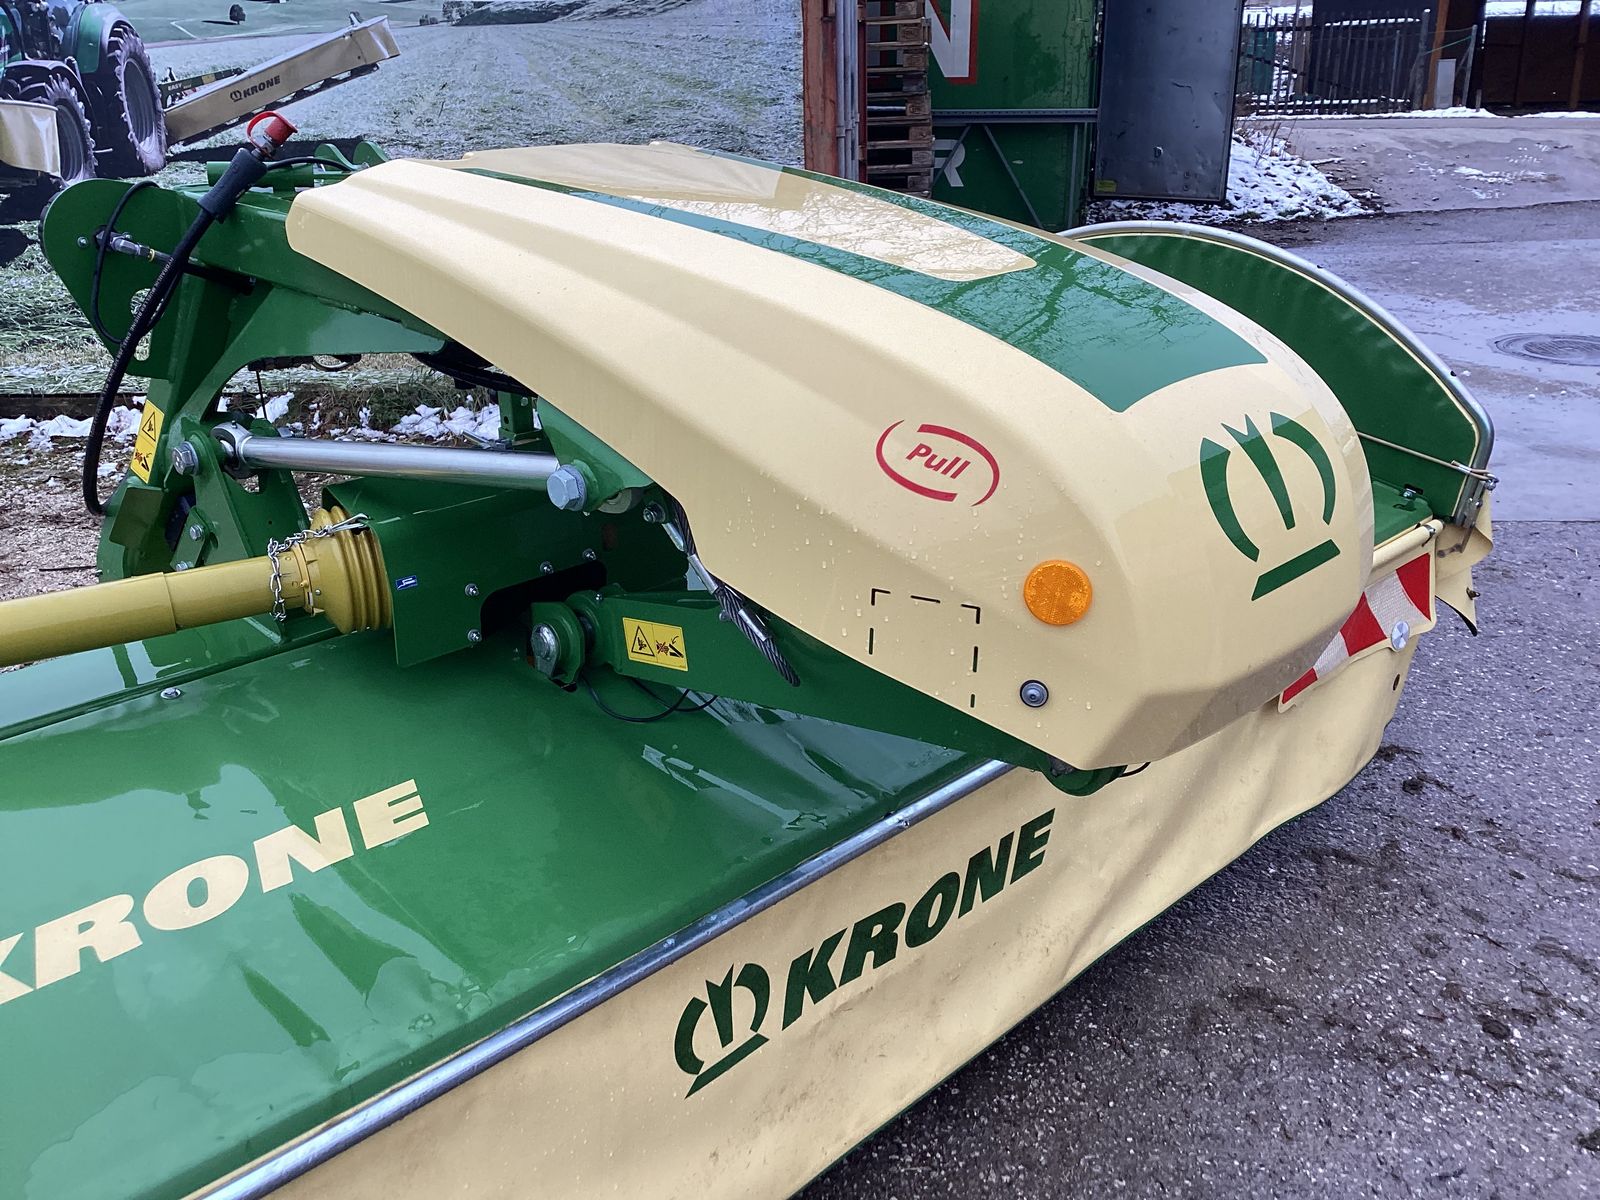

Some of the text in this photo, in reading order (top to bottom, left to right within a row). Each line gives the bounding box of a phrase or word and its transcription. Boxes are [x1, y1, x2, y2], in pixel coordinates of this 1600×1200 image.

[167, 83, 182, 91] EASY
[243, 75, 281, 98] KRONE
[905, 442, 971, 480] Pull
[781, 807, 1056, 1032] KRONE
